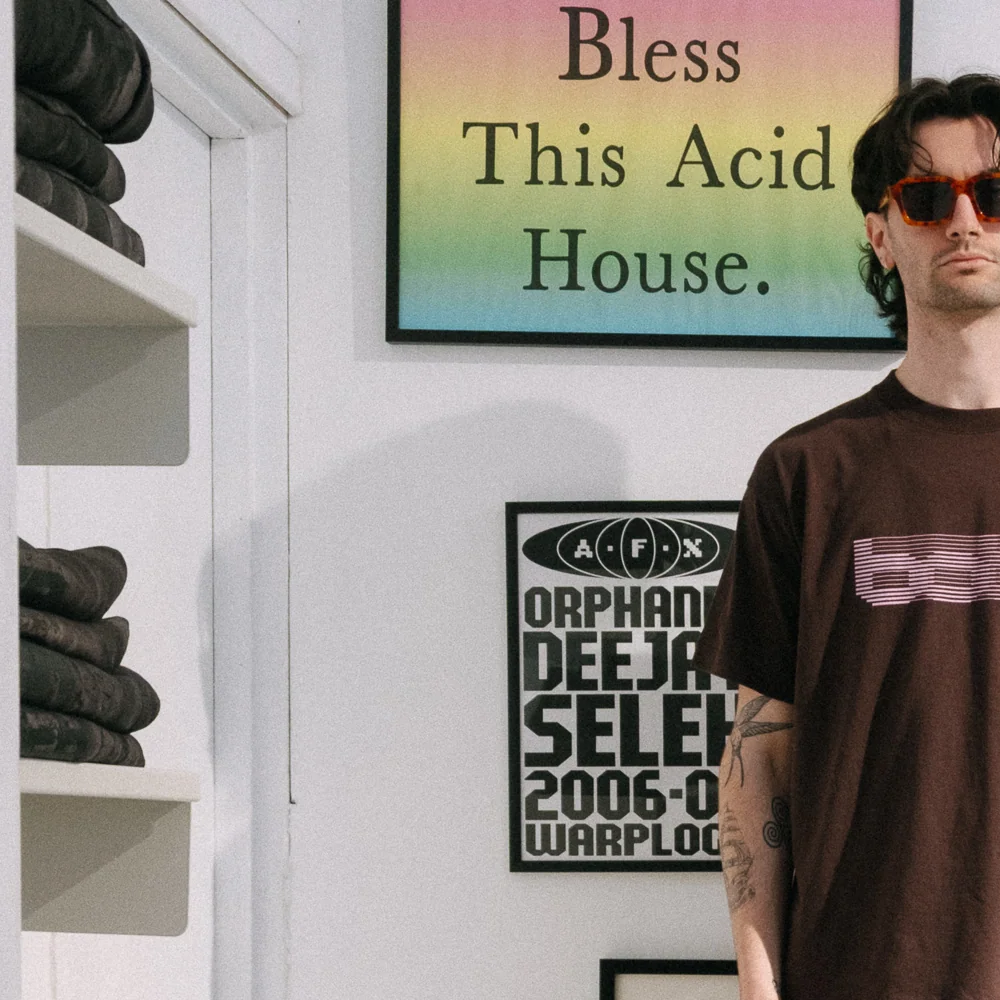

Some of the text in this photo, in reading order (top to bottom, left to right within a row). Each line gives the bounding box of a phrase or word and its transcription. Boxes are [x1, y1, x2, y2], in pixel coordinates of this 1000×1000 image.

[558, 6, 742, 82] Bless
[462, 121, 835, 190] This Acid
[522, 228, 770, 295] House.
[523, 631, 738, 691] DEEJA
